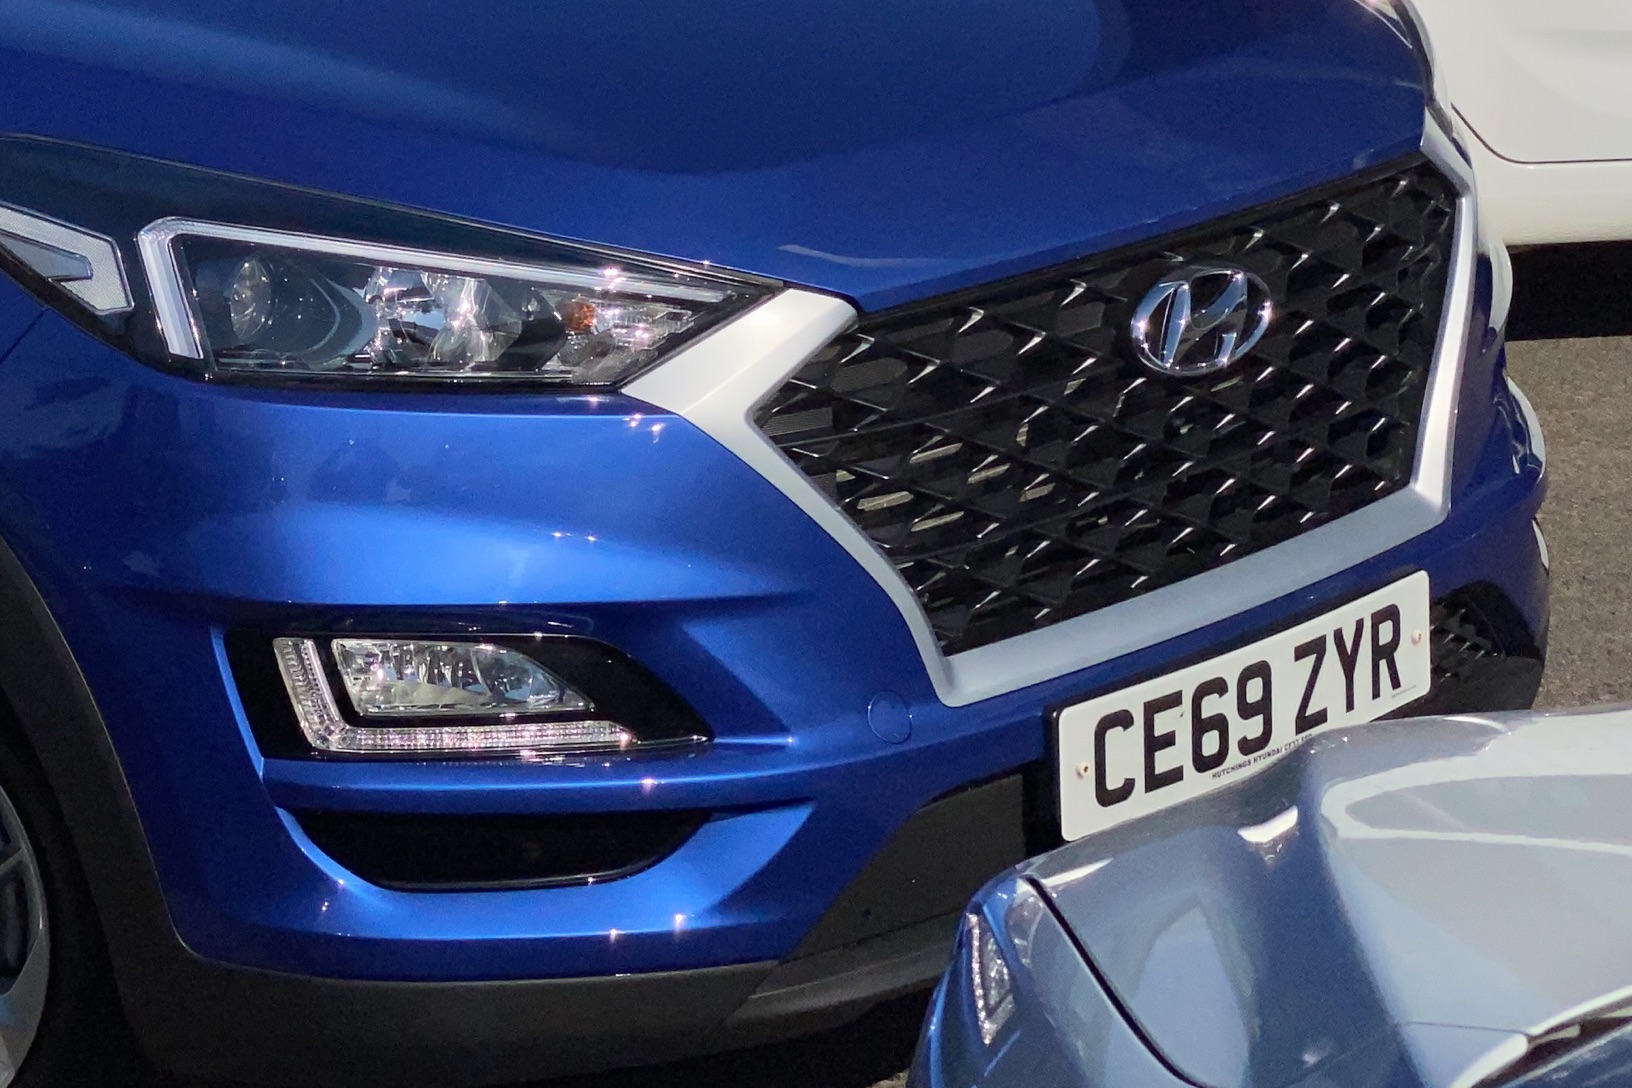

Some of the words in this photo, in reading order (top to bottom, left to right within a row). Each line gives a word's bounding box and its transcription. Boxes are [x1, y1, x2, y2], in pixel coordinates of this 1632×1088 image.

[1094, 660, 1273, 808] CE69
[1293, 603, 1402, 735] ZYR
[1211, 758, 1252, 779] HUTCHINGS
[1253, 746, 1283, 764] HYUNDAI
